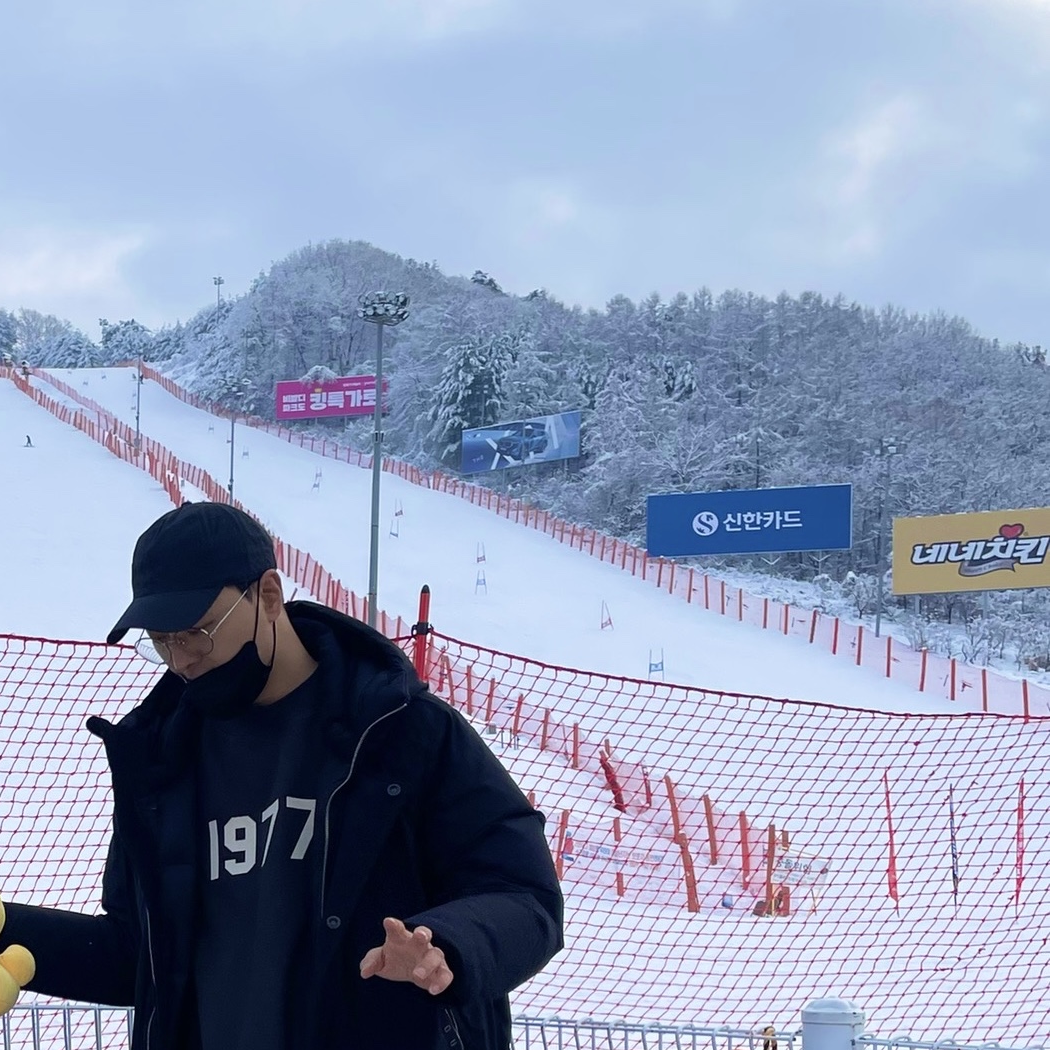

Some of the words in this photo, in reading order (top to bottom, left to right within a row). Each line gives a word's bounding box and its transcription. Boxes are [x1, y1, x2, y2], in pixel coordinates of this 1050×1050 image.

[723, 511, 803, 532] 신한카드
[911, 536, 1050, 565] 네네치킨
[208, 795, 317, 881] 1977
